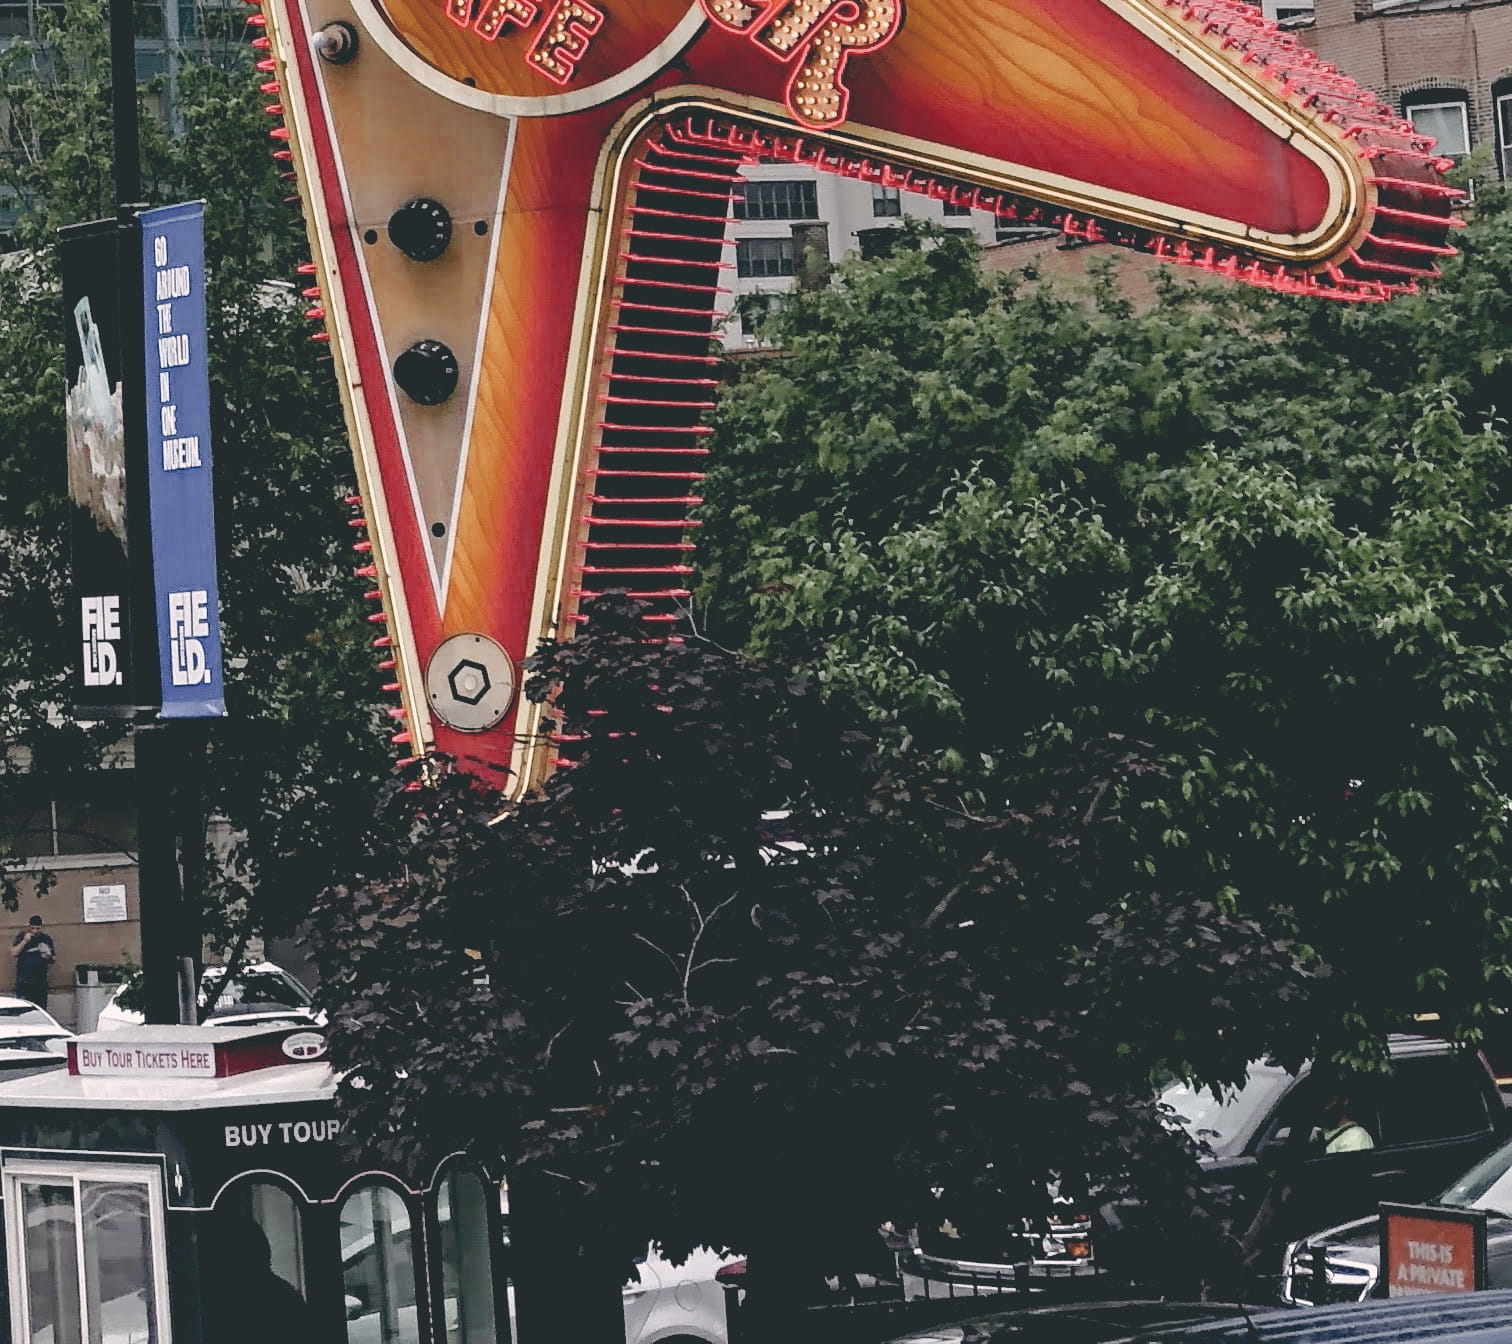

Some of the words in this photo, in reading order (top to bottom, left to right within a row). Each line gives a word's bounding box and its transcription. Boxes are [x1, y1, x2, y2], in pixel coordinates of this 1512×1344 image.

[154, 235, 168, 268] GO
[156, 265, 190, 301] AROUND
[157, 302, 172, 334] THE
[158, 334, 190, 369] WORLD
[161, 404, 177, 437] ONE
[224, 1122, 273, 1147] BUY
[1408, 1239, 1437, 1263] THIS
[1439, 1243, 1454, 1264] IS
[1397, 1263, 1409, 1282] A
[1410, 1263, 1465, 1289] PRIVATE
